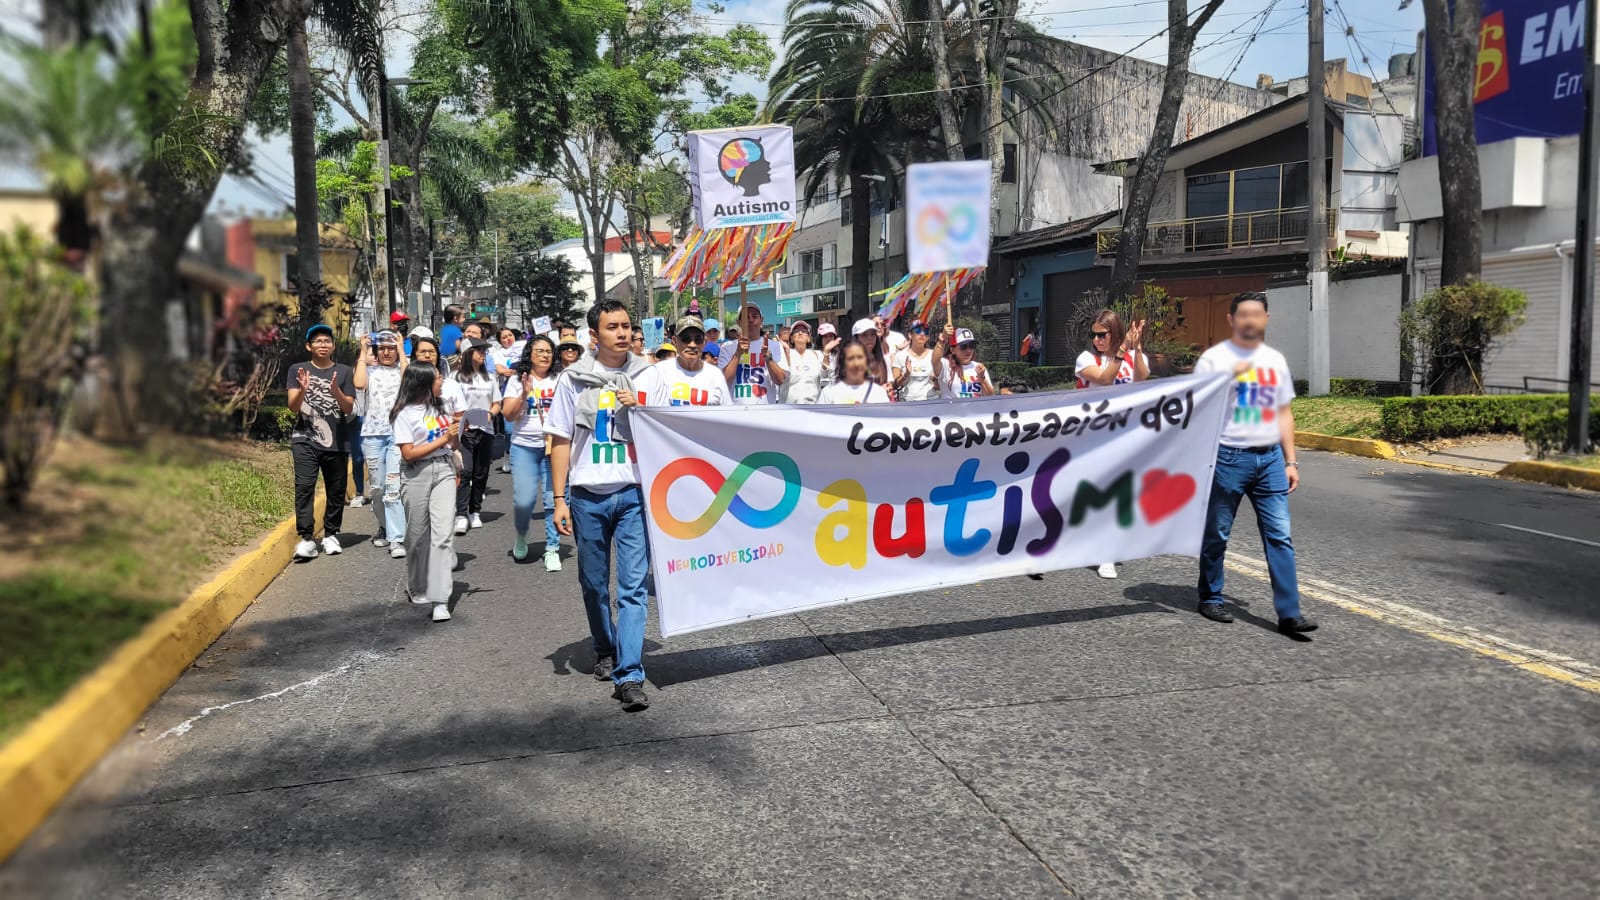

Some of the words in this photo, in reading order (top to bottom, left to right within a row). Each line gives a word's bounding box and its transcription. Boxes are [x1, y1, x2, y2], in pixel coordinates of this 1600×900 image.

[713, 200, 790, 217] Autismo
[671, 382, 709, 406] au
[1140, 390, 1194, 432] del
[667, 543, 784, 574] NEURODIVERSIDAD
